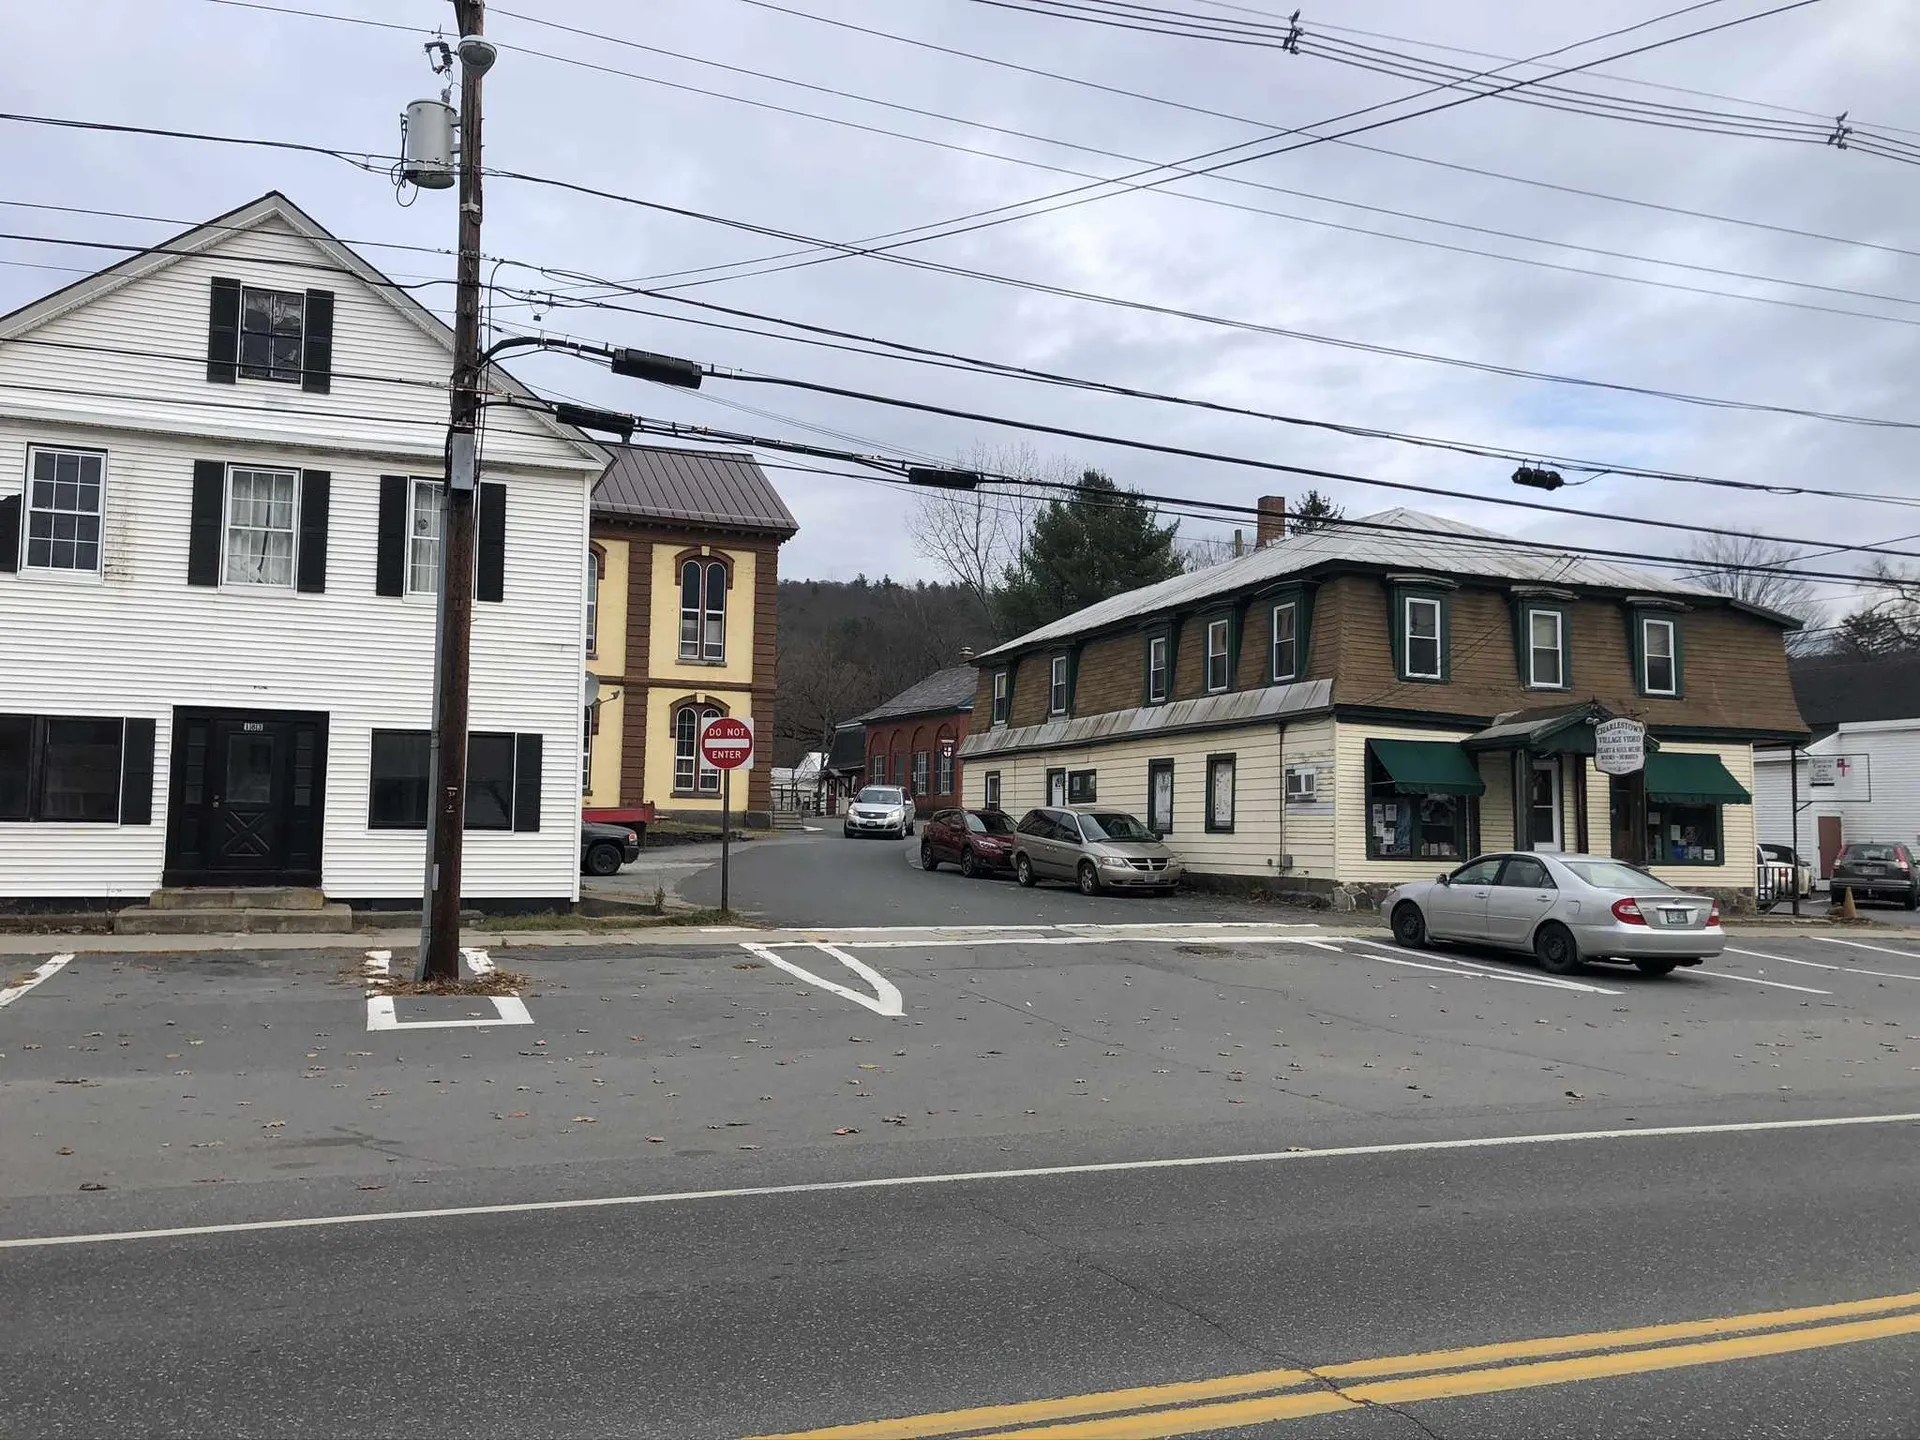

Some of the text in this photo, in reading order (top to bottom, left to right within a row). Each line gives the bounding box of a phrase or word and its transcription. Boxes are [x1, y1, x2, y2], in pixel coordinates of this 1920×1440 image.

[709, 728, 745, 736] DO NOT
[1596, 721, 1643, 735] CHARLESTOWN
[1598, 735, 1641, 743] VILLAGE VIDEO
[712, 750, 742, 759] ENTER
